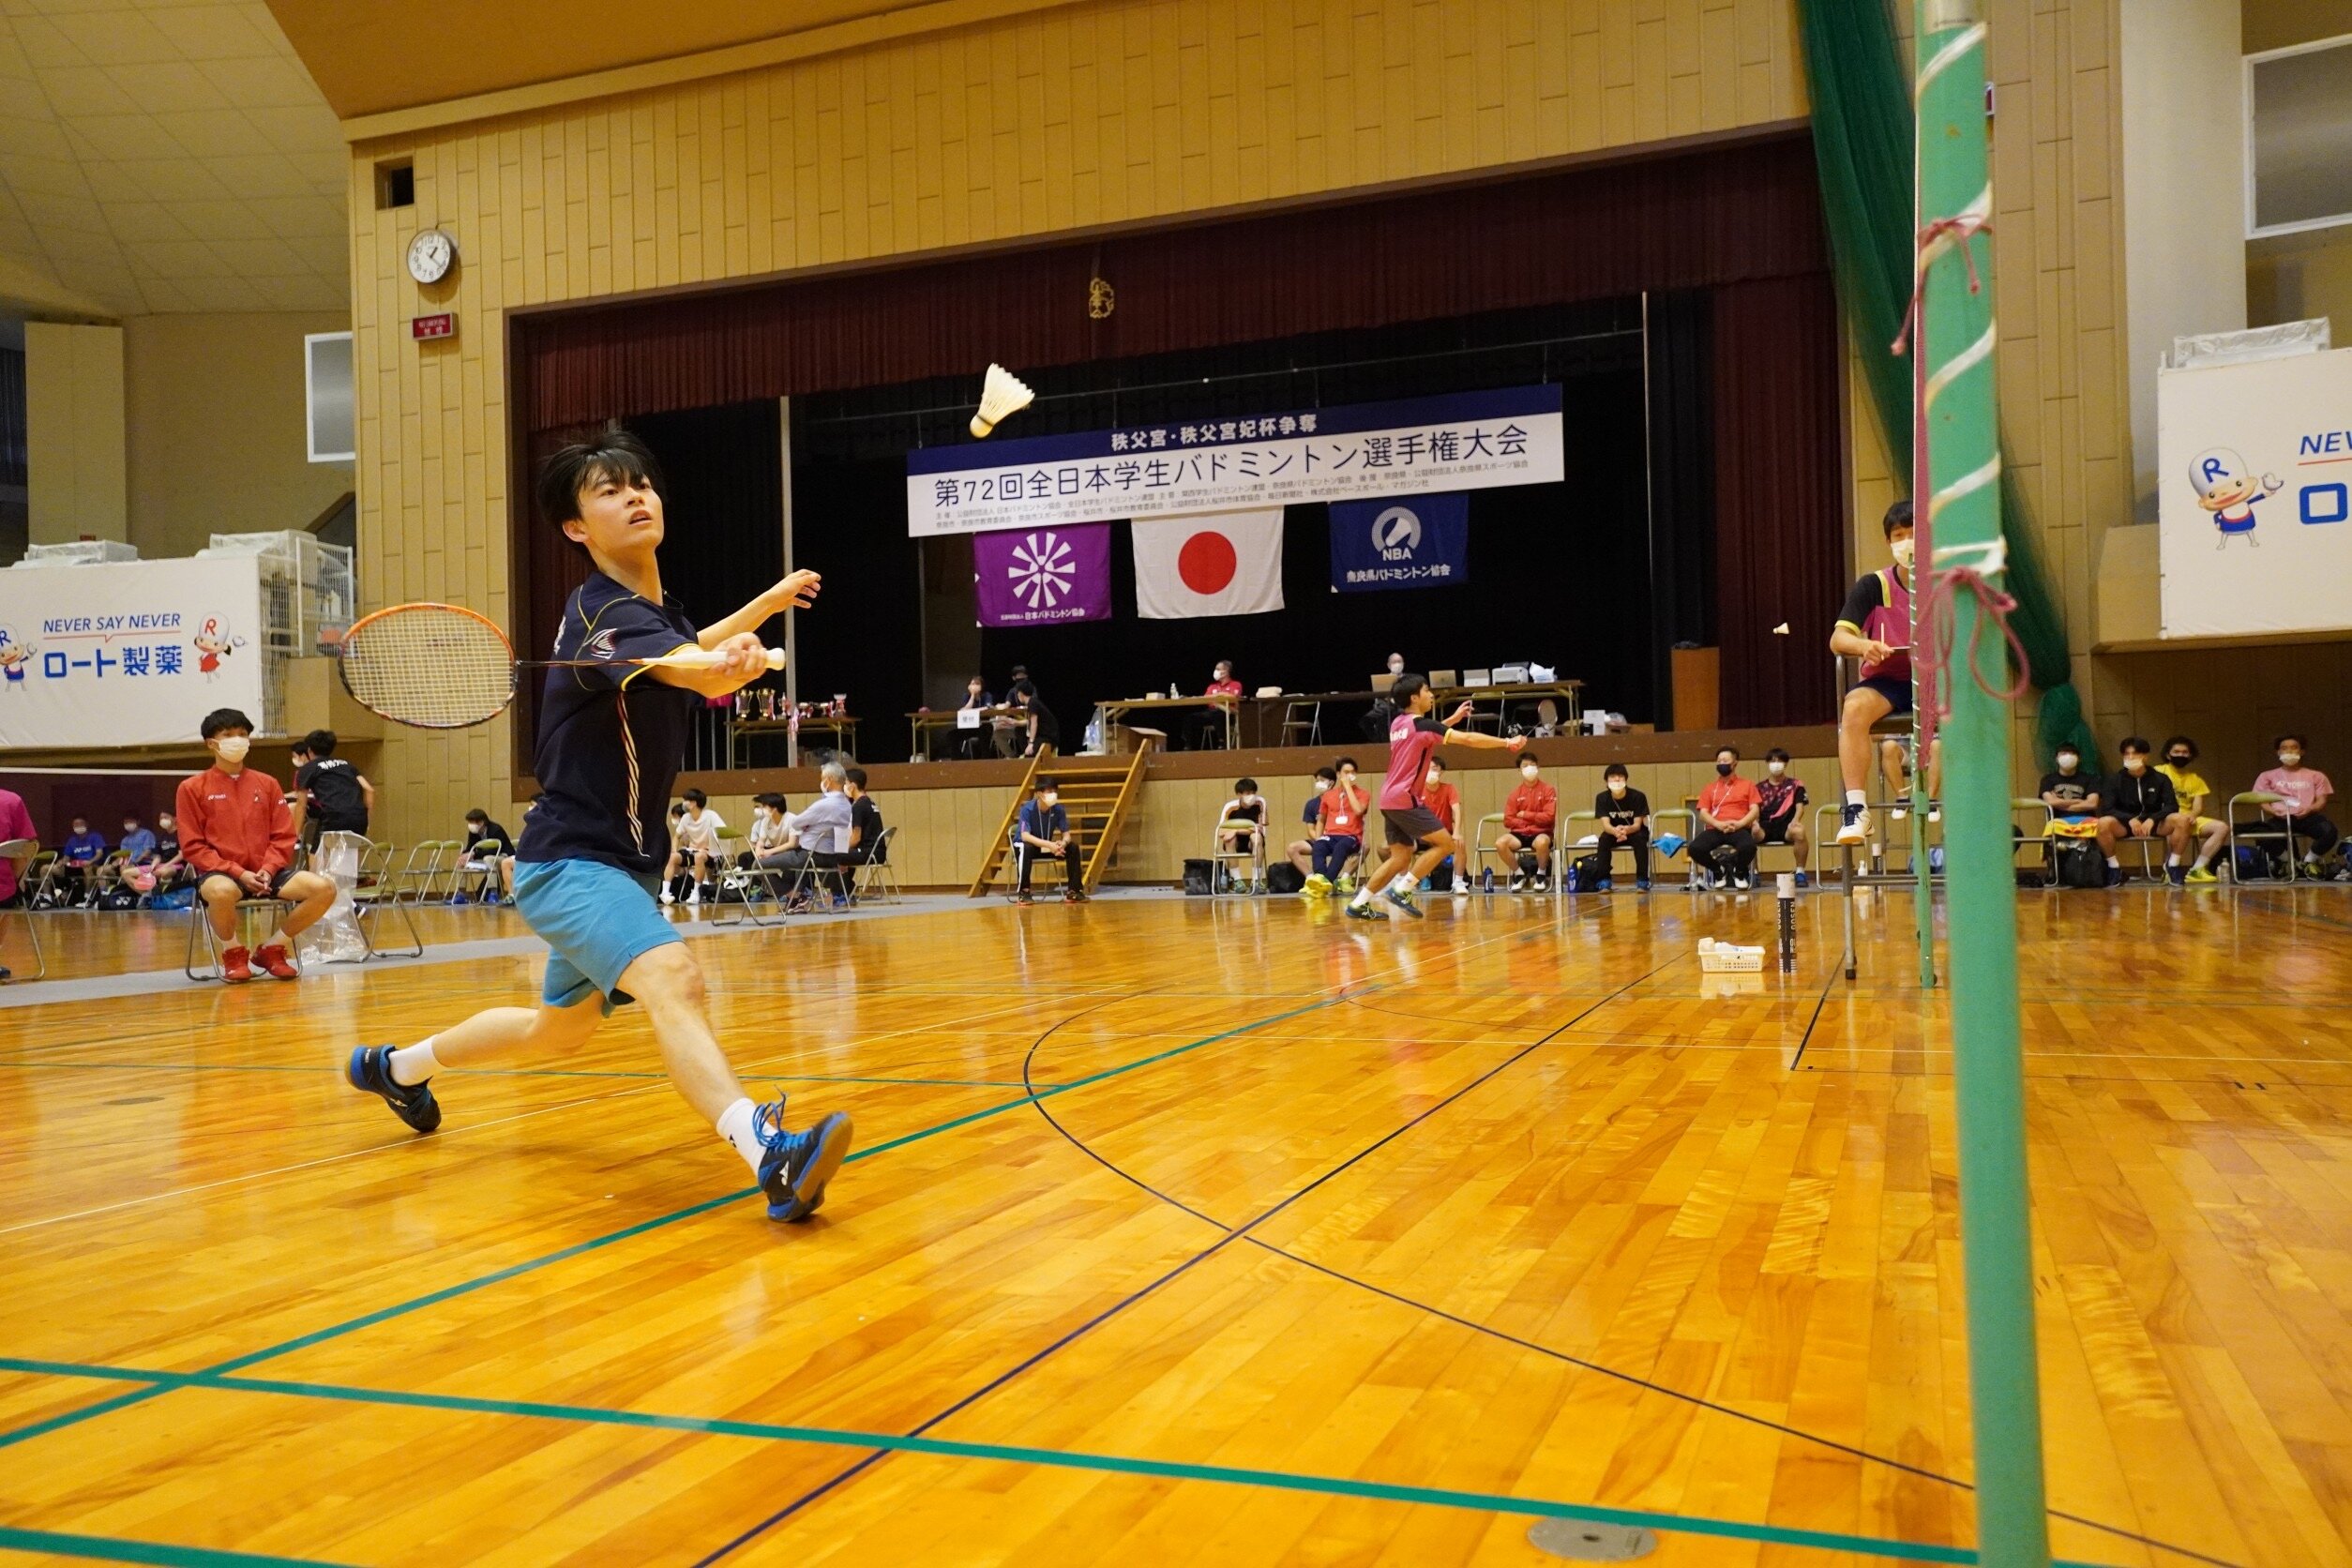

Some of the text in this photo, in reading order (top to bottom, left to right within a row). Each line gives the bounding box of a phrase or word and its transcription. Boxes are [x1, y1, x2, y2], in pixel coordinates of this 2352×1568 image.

[935, 424, 1528, 506] 第72回全日本学生バドミントン選手権大会
[1382, 548, 1412, 561] NBA
[43, 613, 181, 633] NEVER SAY NEVER
[44, 645, 182, 678] ロート製薬
